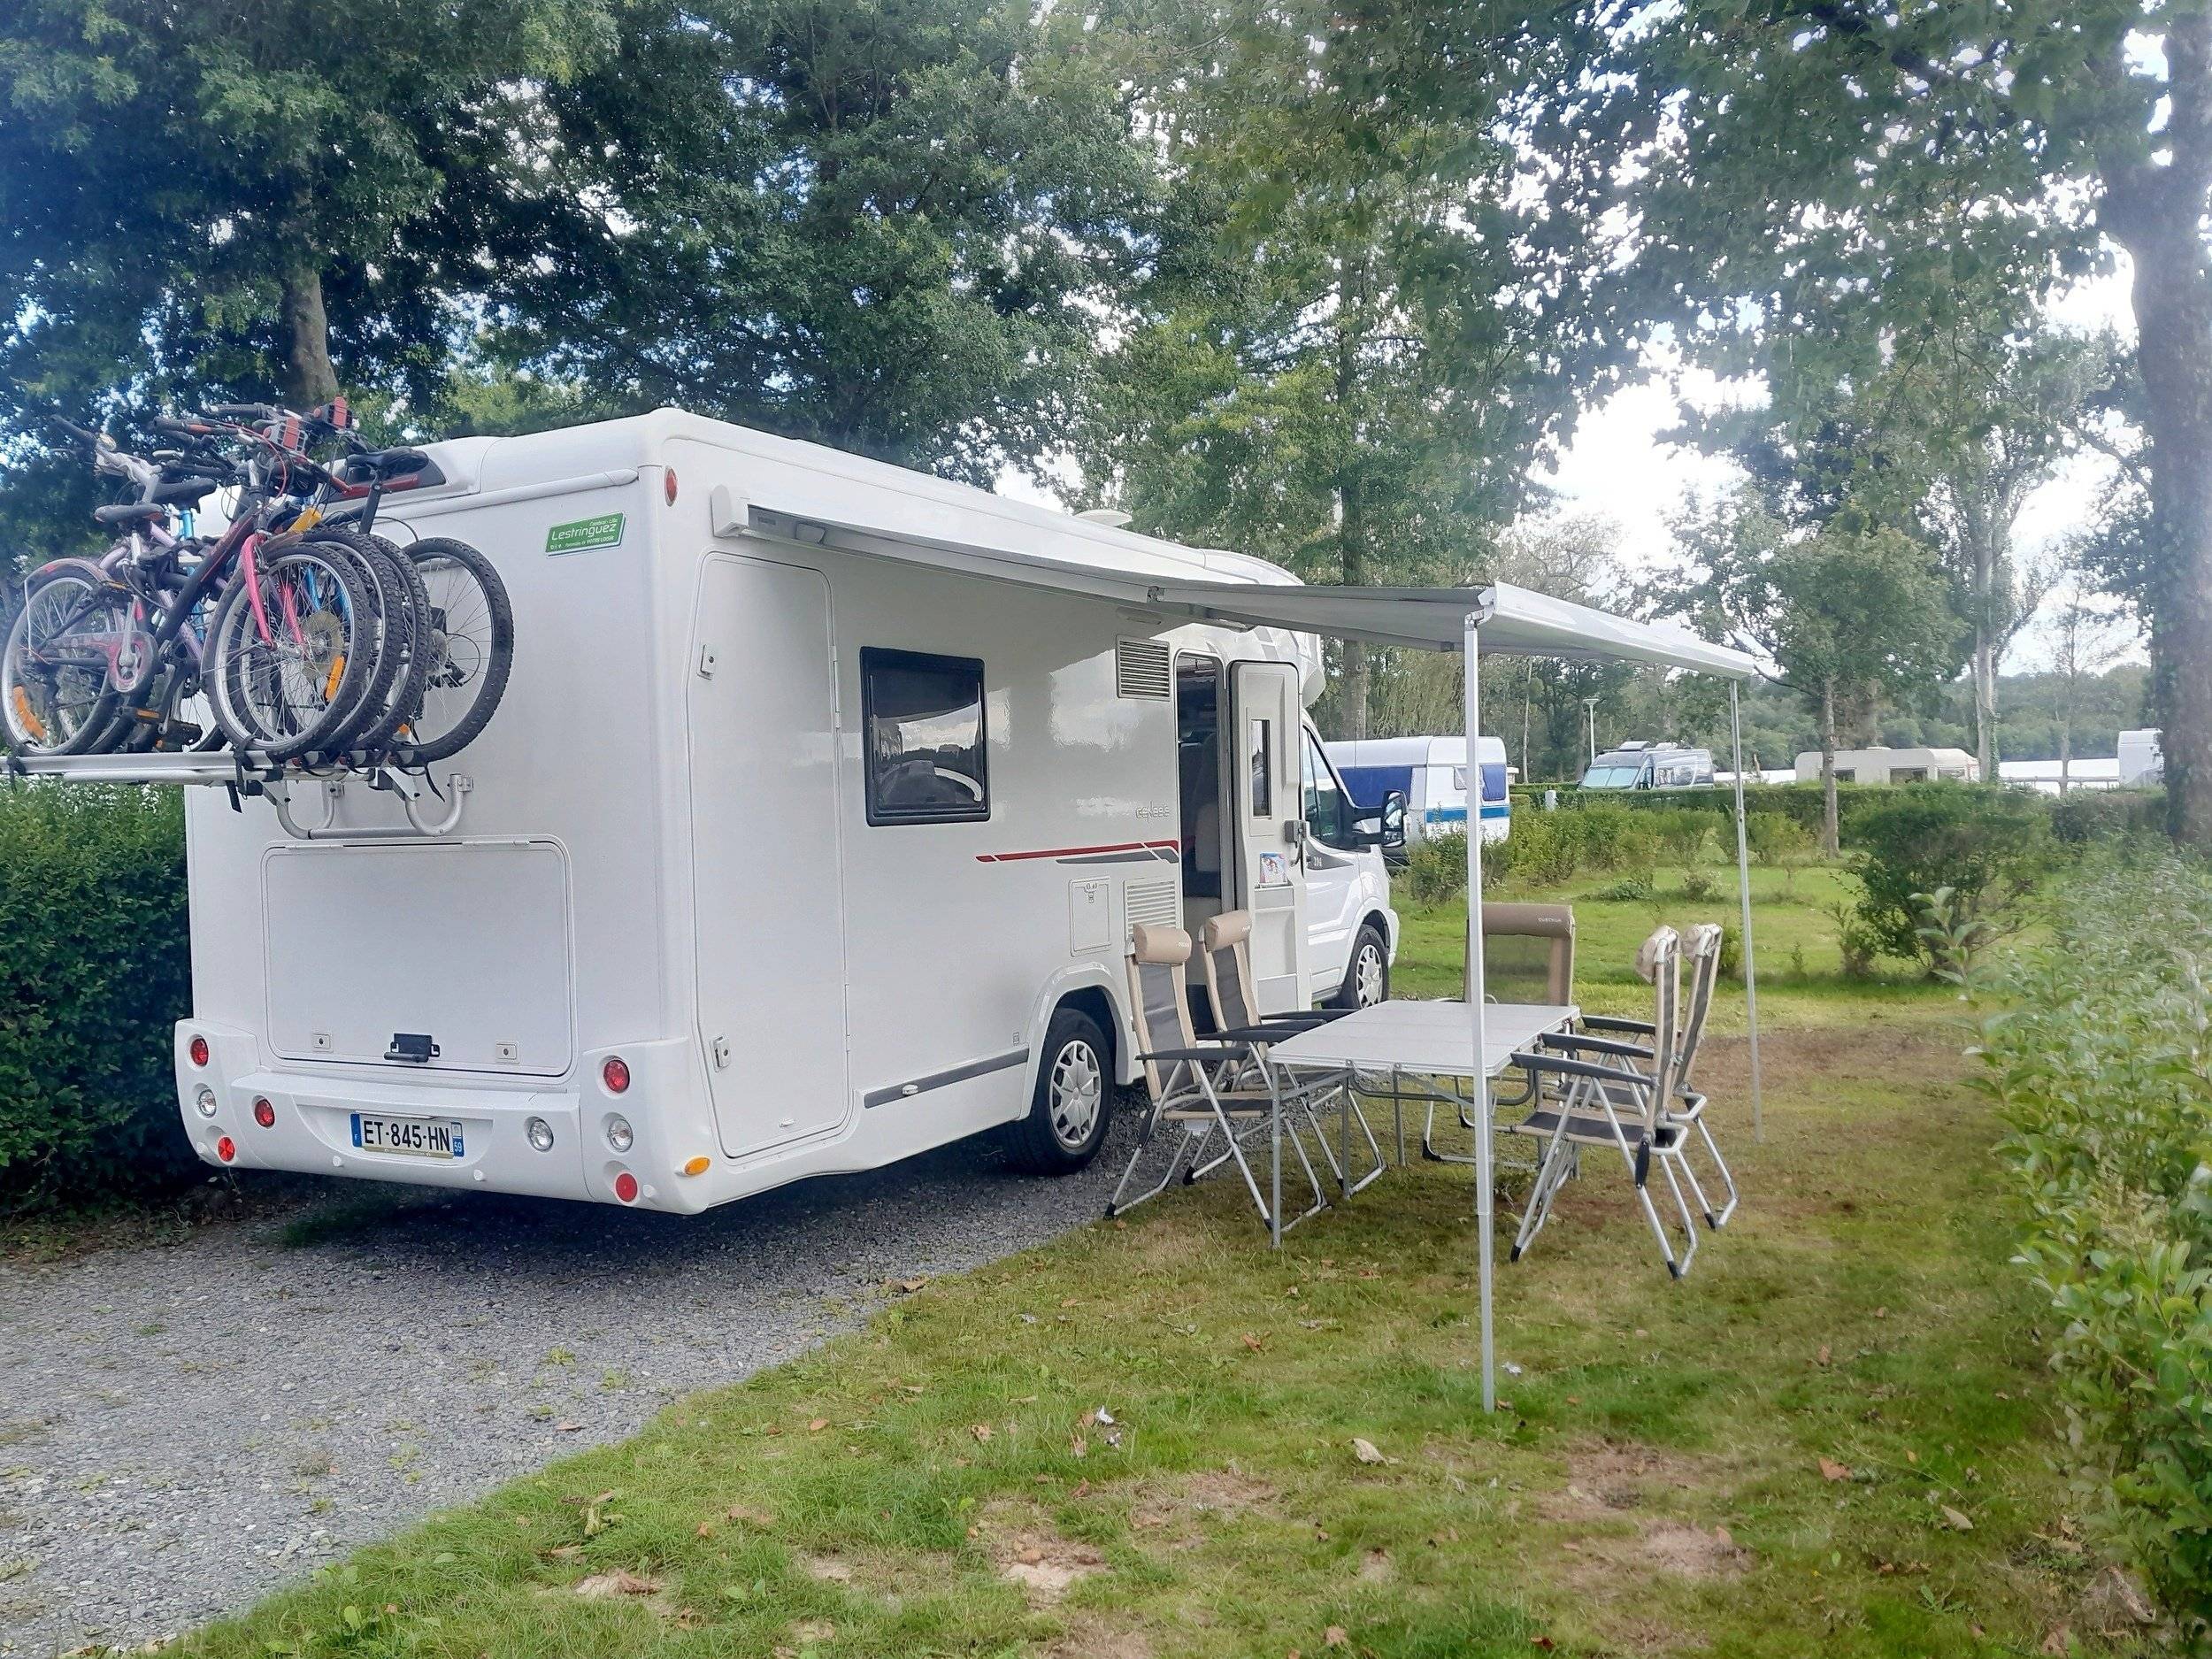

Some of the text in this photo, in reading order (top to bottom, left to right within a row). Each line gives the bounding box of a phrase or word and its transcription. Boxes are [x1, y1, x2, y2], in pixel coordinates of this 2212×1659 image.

[551, 523, 617, 541] Lestringuez
[364, 1120, 450, 1152] ET-845-HN
[455, 1143, 462, 1153] 59
